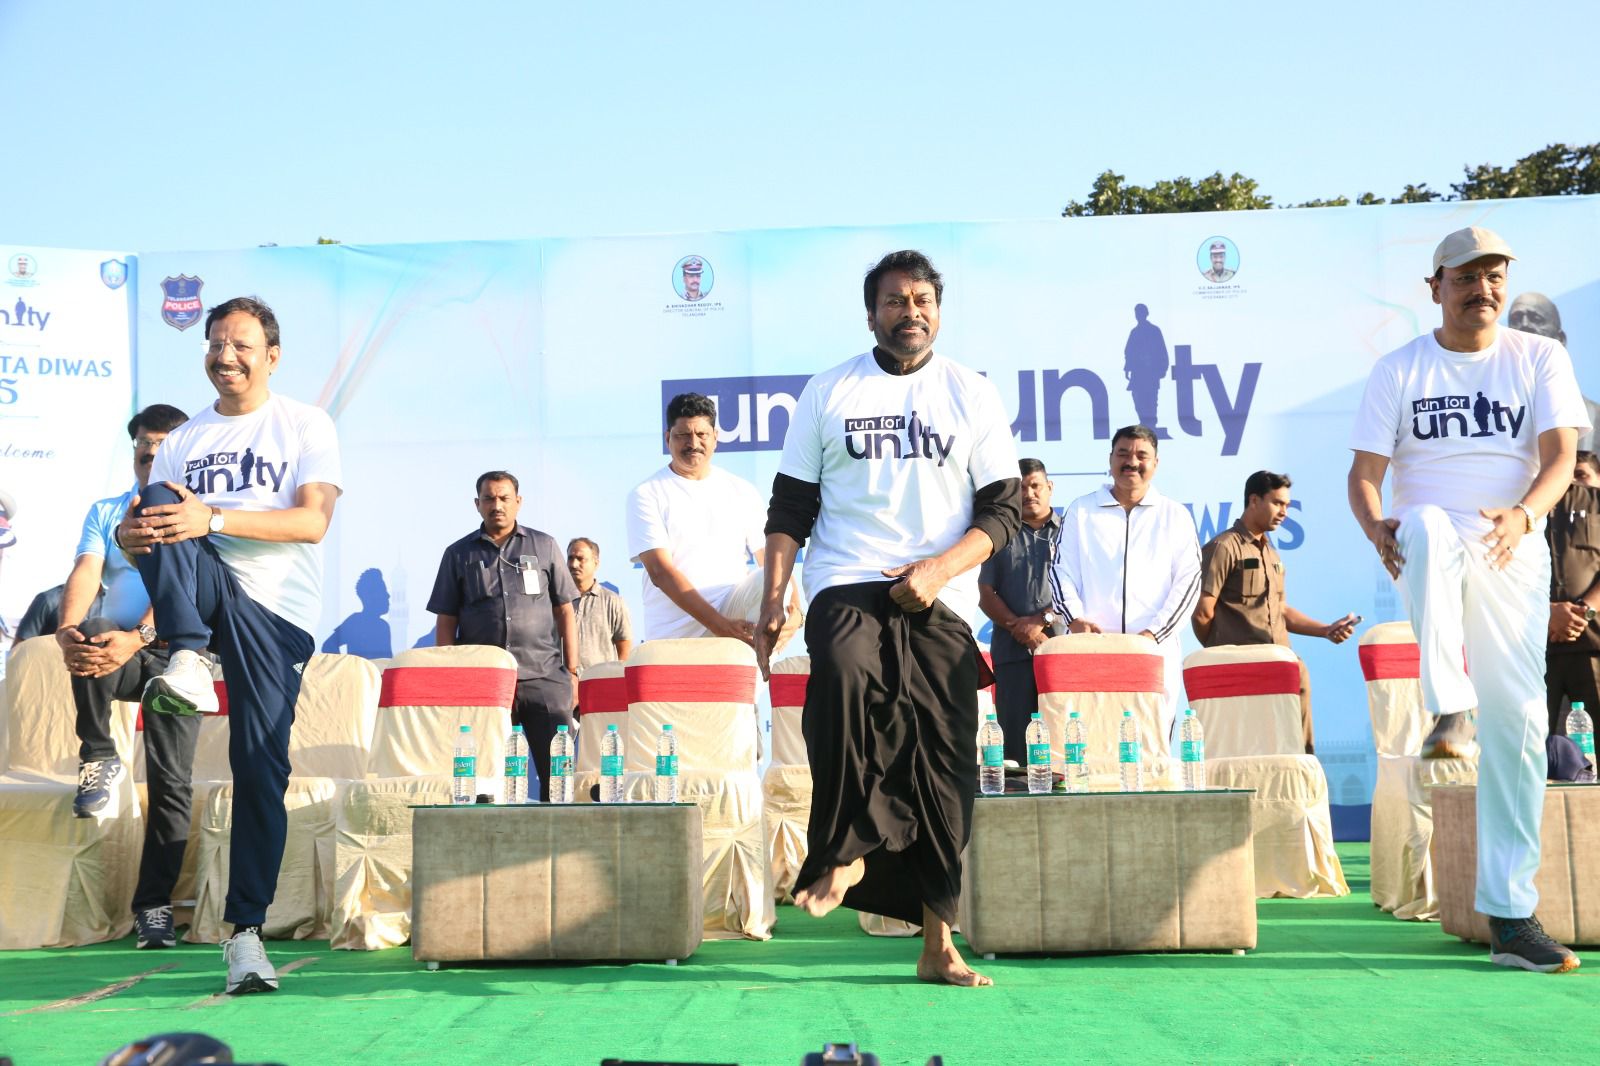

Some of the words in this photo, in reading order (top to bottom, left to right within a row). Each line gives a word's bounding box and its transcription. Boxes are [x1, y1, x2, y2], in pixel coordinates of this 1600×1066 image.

[165, 300, 200, 311] POLICE
[37, 357, 113, 378] DIWAS
[1415, 399, 1440, 411] run
[1444, 395, 1466, 410] for
[848, 418, 876, 432] run
[880, 415, 903, 431] for
[1412, 391, 1525, 441] unity
[845, 410, 956, 467] unity
[185, 447, 289, 495] unity
[188, 457, 210, 470] run
[213, 453, 235, 465] for
